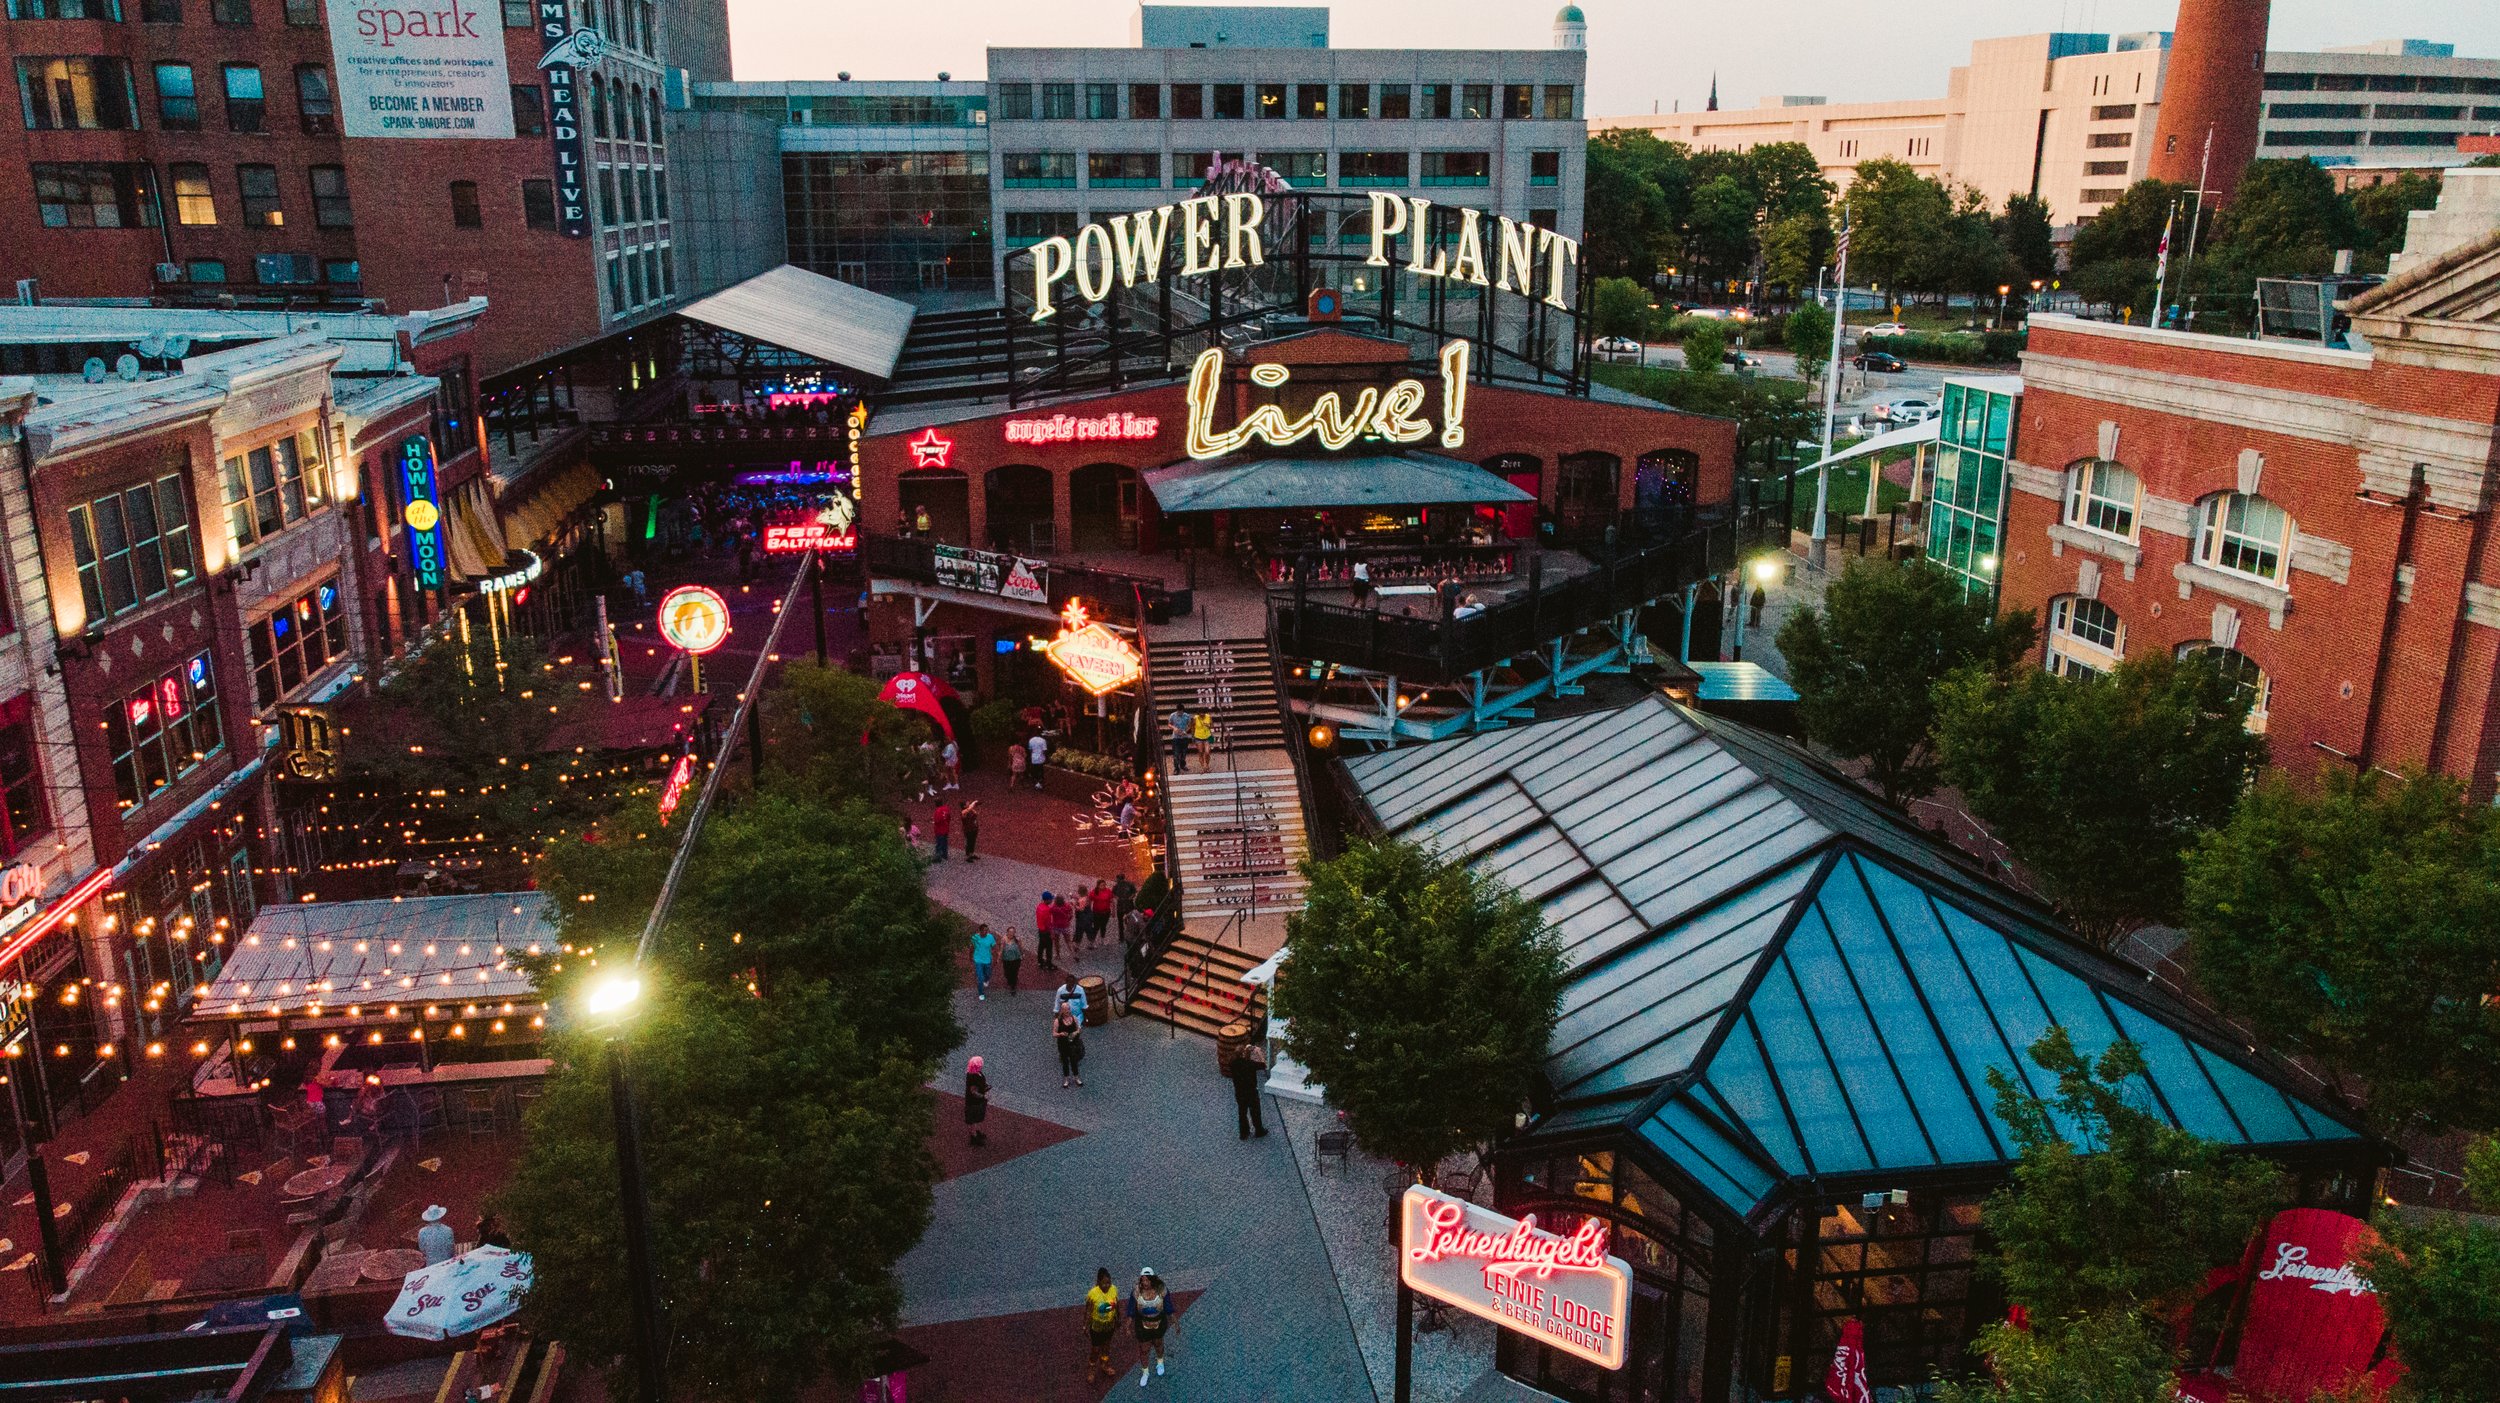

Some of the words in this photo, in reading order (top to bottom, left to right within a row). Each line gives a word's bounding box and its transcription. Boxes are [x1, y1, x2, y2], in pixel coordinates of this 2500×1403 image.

[356, 0, 480, 47] spark
[347, 56, 387, 65] creative
[389, 55, 421, 66] offices
[423, 56, 442, 66] and
[444, 57, 494, 68] workspace
[369, 96, 418, 112] BECOME
[422, 97, 430, 112] A
[433, 97, 484, 112] MEMBER
[383, 116, 475, 130] SPARK-BMORE.COM
[550, 70, 577, 140] HEAD
[561, 152, 583, 220] LIVE
[1029, 192, 1264, 323] POWER
[1366, 191, 1578, 311] PLANT
[1187, 338, 1469, 460] Live!
[1006, 415, 1076, 443] angels
[1077, 413, 1121, 440] rock
[1121, 412, 1159, 438] bar
[406, 444, 427, 499] HOWL
[411, 503, 426, 515] at
[768, 526, 826, 538] PBR
[415, 532, 438, 585] MOON
[479, 570, 527, 595] RAMS
[1062, 652, 1125, 677] TAVERN
[1484, 1270, 1546, 1312] LEINIE
[1552, 1294, 1615, 1340] LODGE
[1491, 1297, 1503, 1313] &
[1505, 1304, 1542, 1329] BEER
[1546, 1318, 1603, 1354] GARDEN
